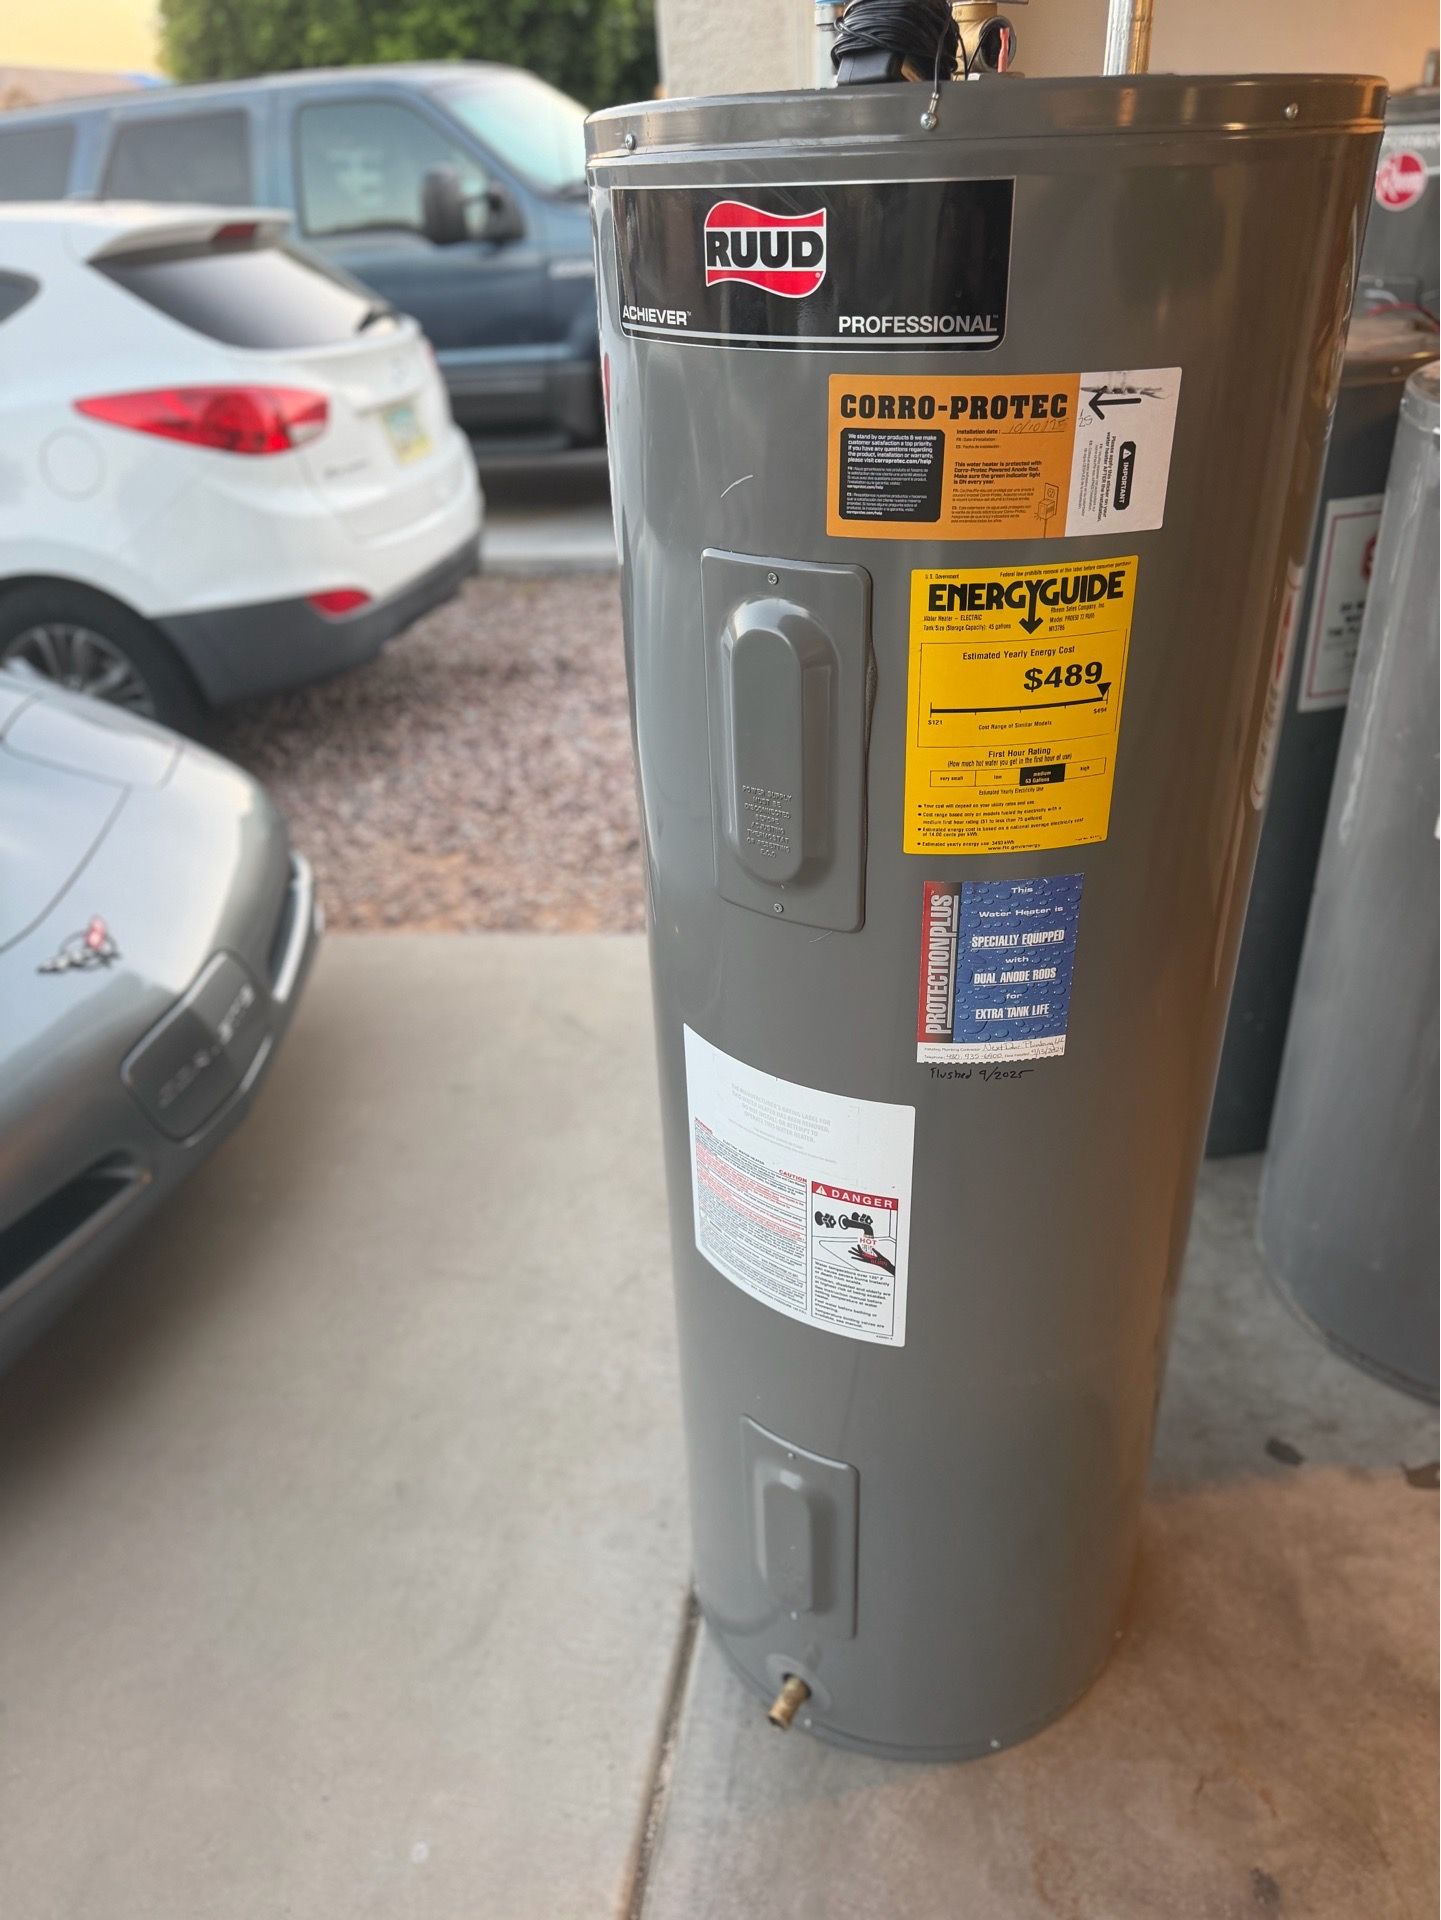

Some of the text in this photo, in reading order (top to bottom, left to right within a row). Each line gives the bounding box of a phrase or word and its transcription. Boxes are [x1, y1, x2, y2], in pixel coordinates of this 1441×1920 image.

[706, 230, 824, 268] RUUD
[840, 394, 1067, 420] CORRO-PROTEC
[1119, 462, 1129, 503] IMPORTANT
[928, 570, 1126, 614] ENERGYGUIDE
[963, 646, 1075, 660] Estimated Yearly Energy Cost
[1024, 662, 1102, 692] $489
[988, 747, 1051, 758] First Hour Rating
[1015, 908, 1051, 916] Heater
[971, 929, 1065, 948] SPECIALLY EQUIPPED
[925, 895, 952, 1033] PROTECTIONPLUS
[974, 967, 1057, 984] DUAL ANODE RODS
[975, 1004, 1049, 1020] EXTRA TANK LIFE
[931, 1067, 1034, 1081] Flushed 9/2025
[779, 1169, 808, 1183] CAUTION
[831, 1189, 893, 1209] DANGER
[859, 1237, 877, 1245] HOT
